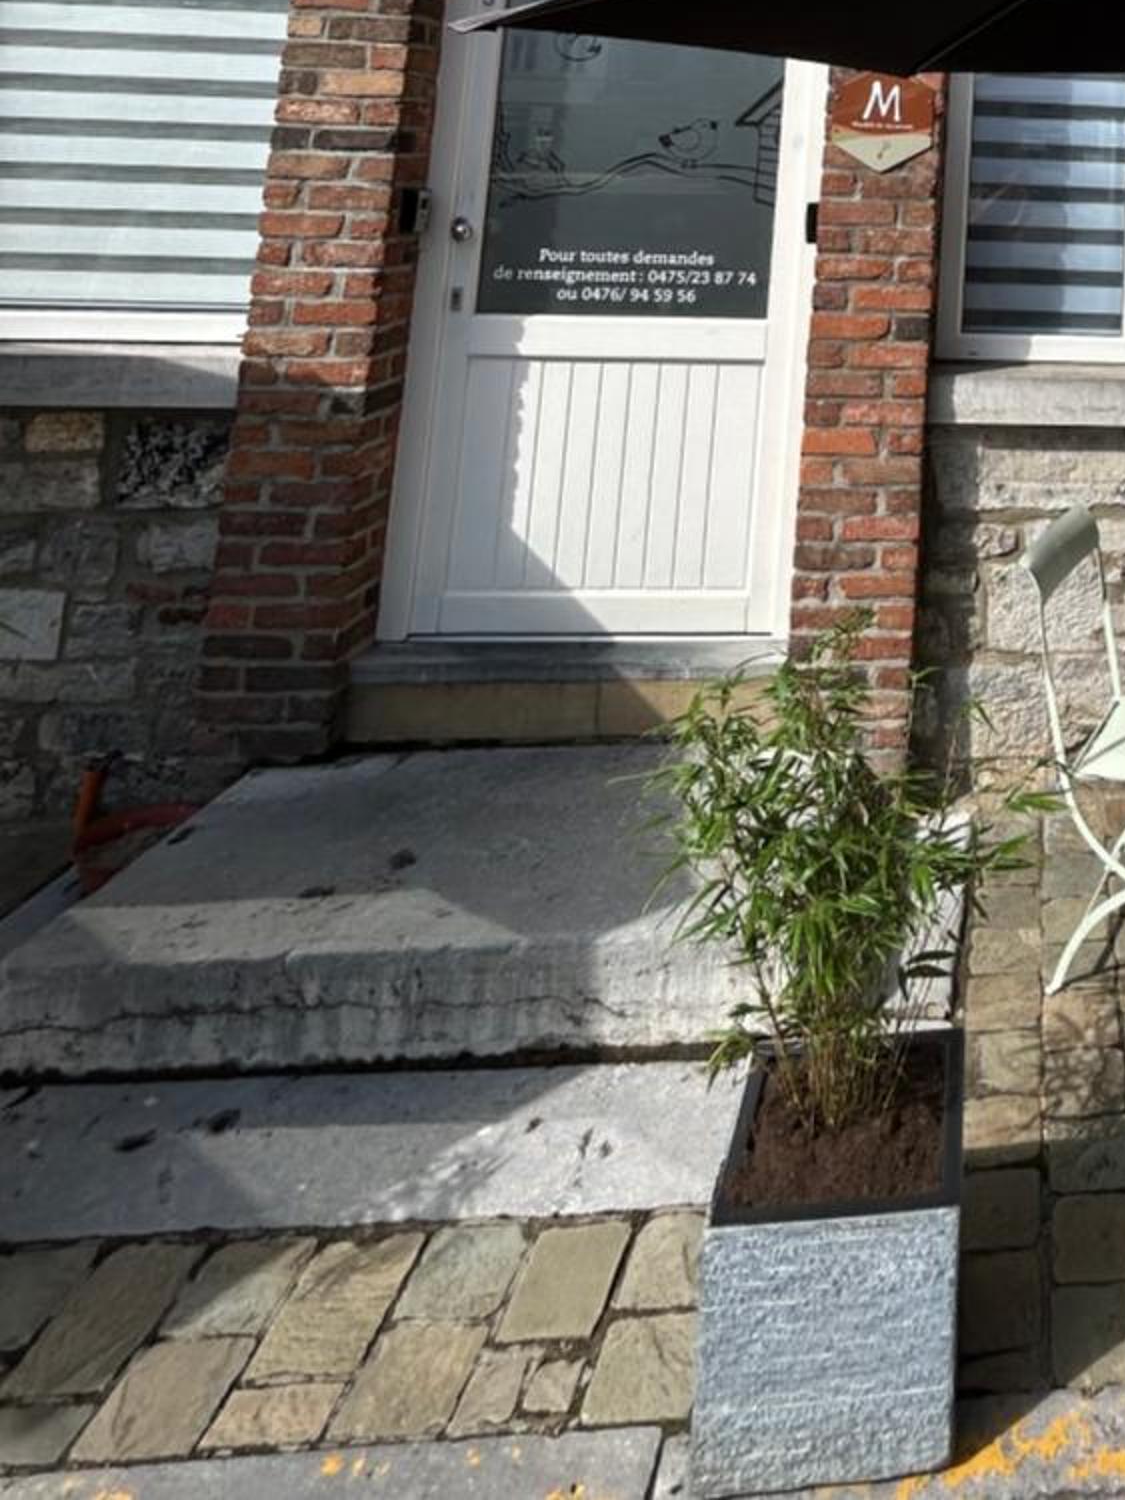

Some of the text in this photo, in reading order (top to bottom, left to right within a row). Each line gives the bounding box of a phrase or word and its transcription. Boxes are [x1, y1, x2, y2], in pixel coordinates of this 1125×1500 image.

[538, 247, 715, 267] Pour toutes demandes
[493, 264, 514, 281] de
[737, 271, 757, 287] 74
[556, 288, 578, 301] ou
[629, 287, 650, 303] 94
